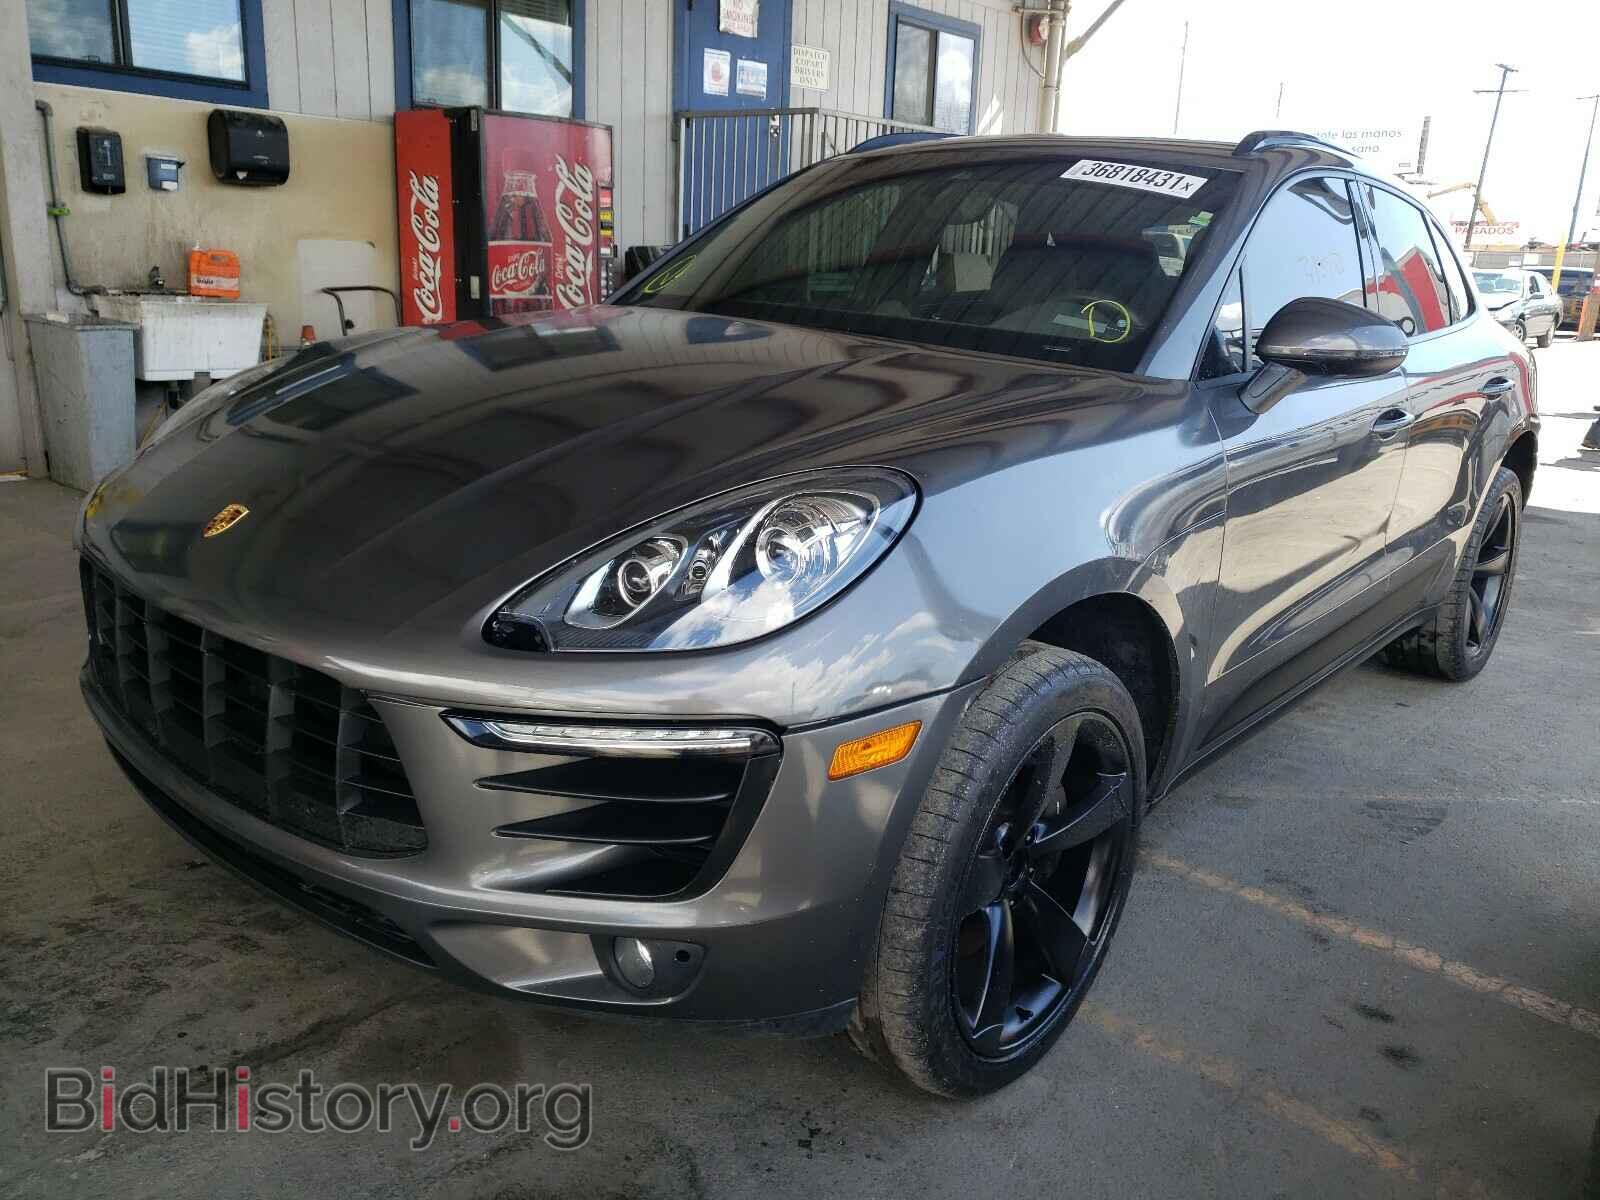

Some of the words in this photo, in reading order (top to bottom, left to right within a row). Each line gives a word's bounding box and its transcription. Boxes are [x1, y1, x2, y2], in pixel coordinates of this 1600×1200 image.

[1361, 129, 1402, 139] manos
[409, 169, 443, 325] Coca-Cola
[491, 247, 545, 292] Coca-Cola
[555, 153, 594, 310] Coca-Cola
